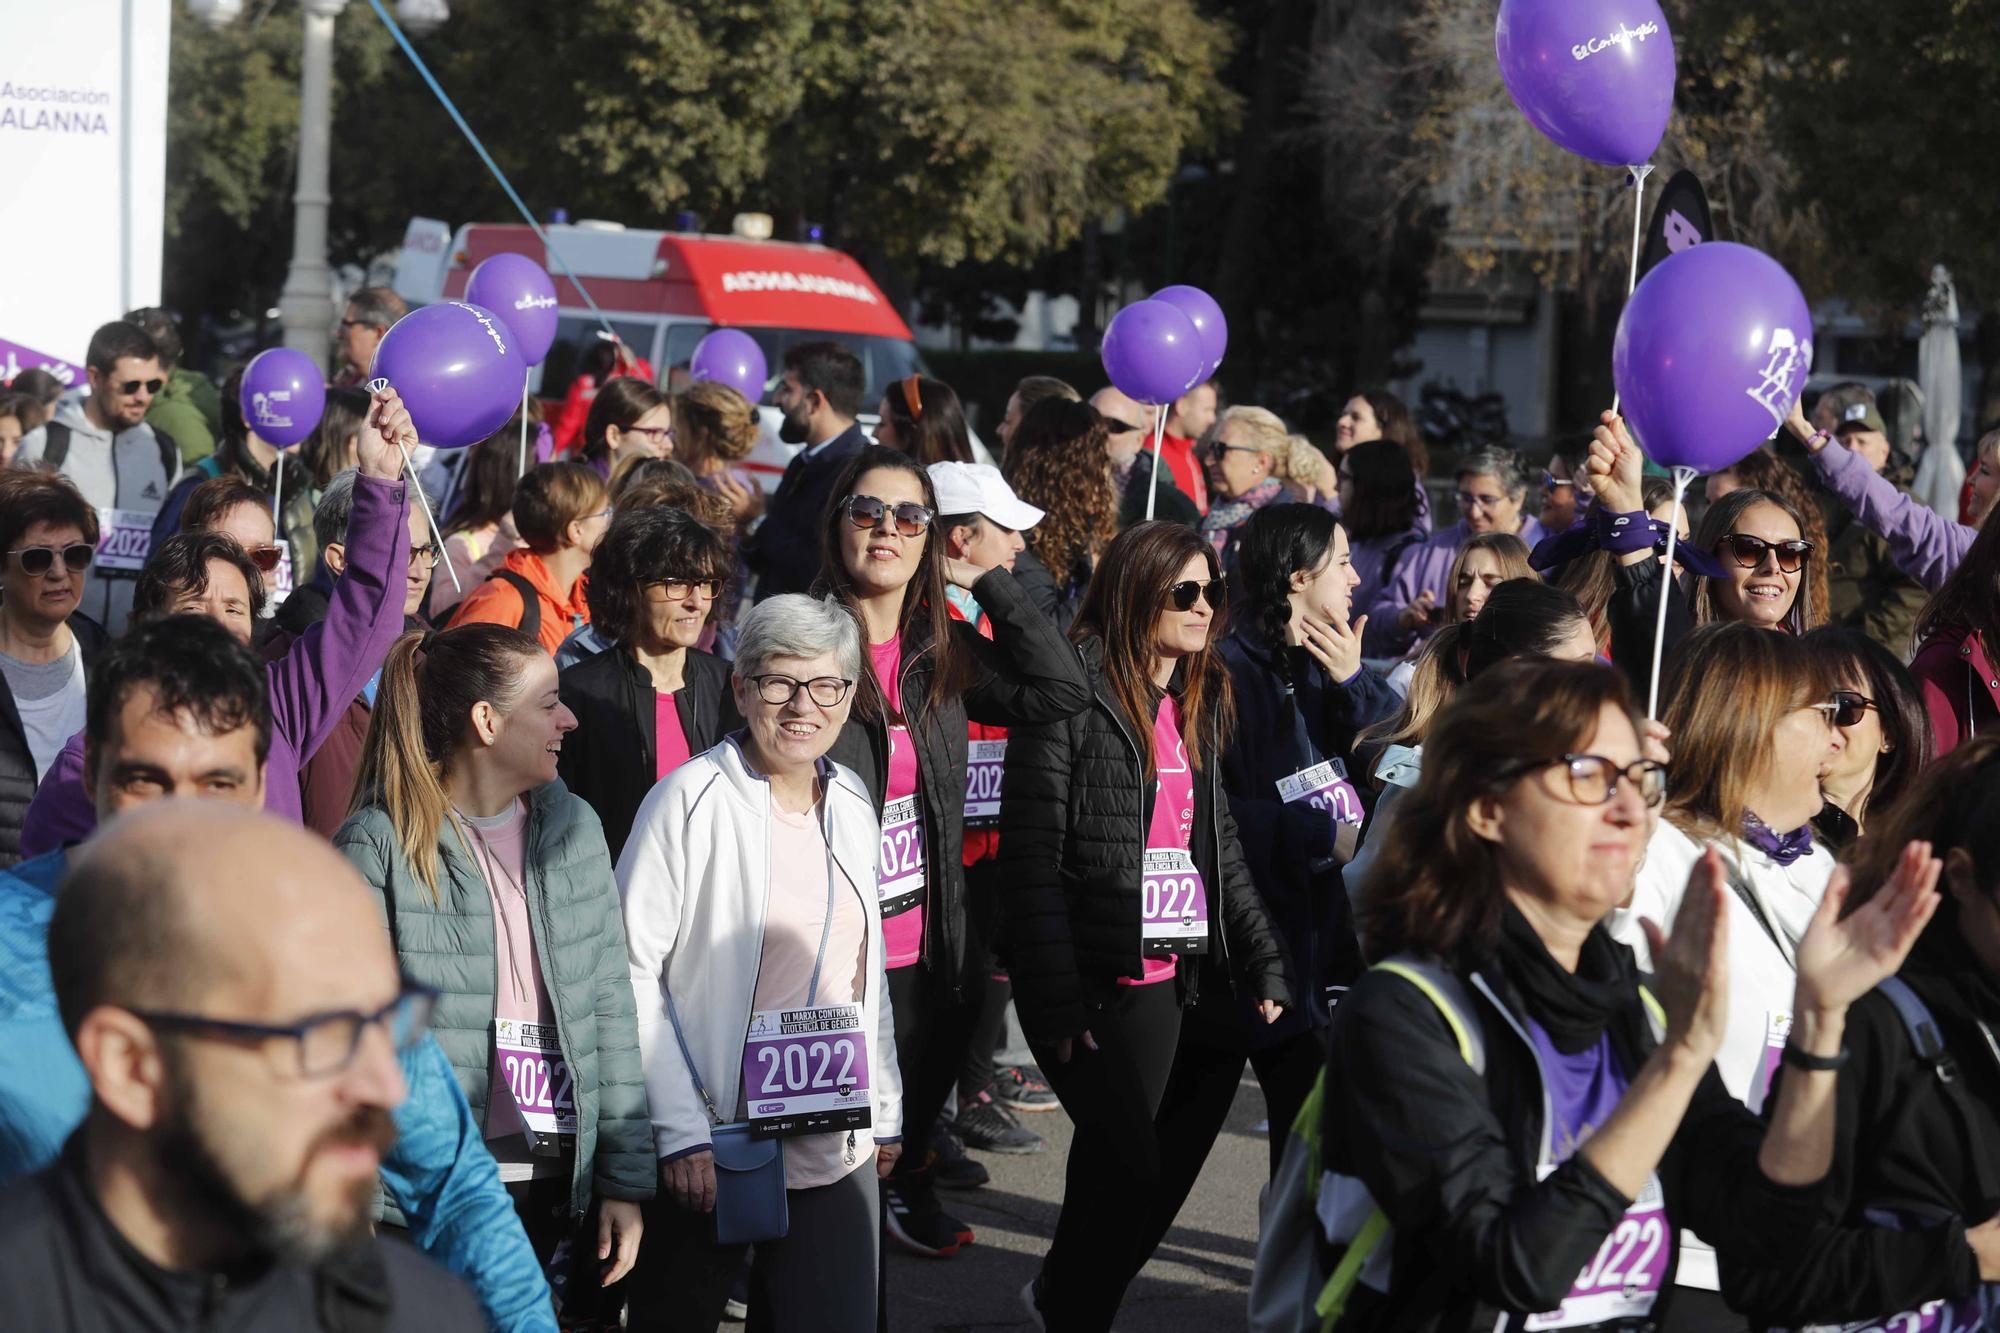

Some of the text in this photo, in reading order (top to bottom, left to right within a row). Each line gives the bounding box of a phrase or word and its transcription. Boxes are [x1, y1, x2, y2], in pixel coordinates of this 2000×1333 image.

[1, 82, 109, 105] Asociación
[0, 107, 108, 134] ALANNA
[966, 765, 1004, 799] 202
[879, 825, 925, 877] 022
[1143, 878, 1197, 919] 022
[783, 1006, 856, 1022] VI MARXA CONTRA LA
[820, 1021, 830, 1030] DE
[506, 1056, 572, 1109] 2022
[757, 1039, 857, 1094] 2022
